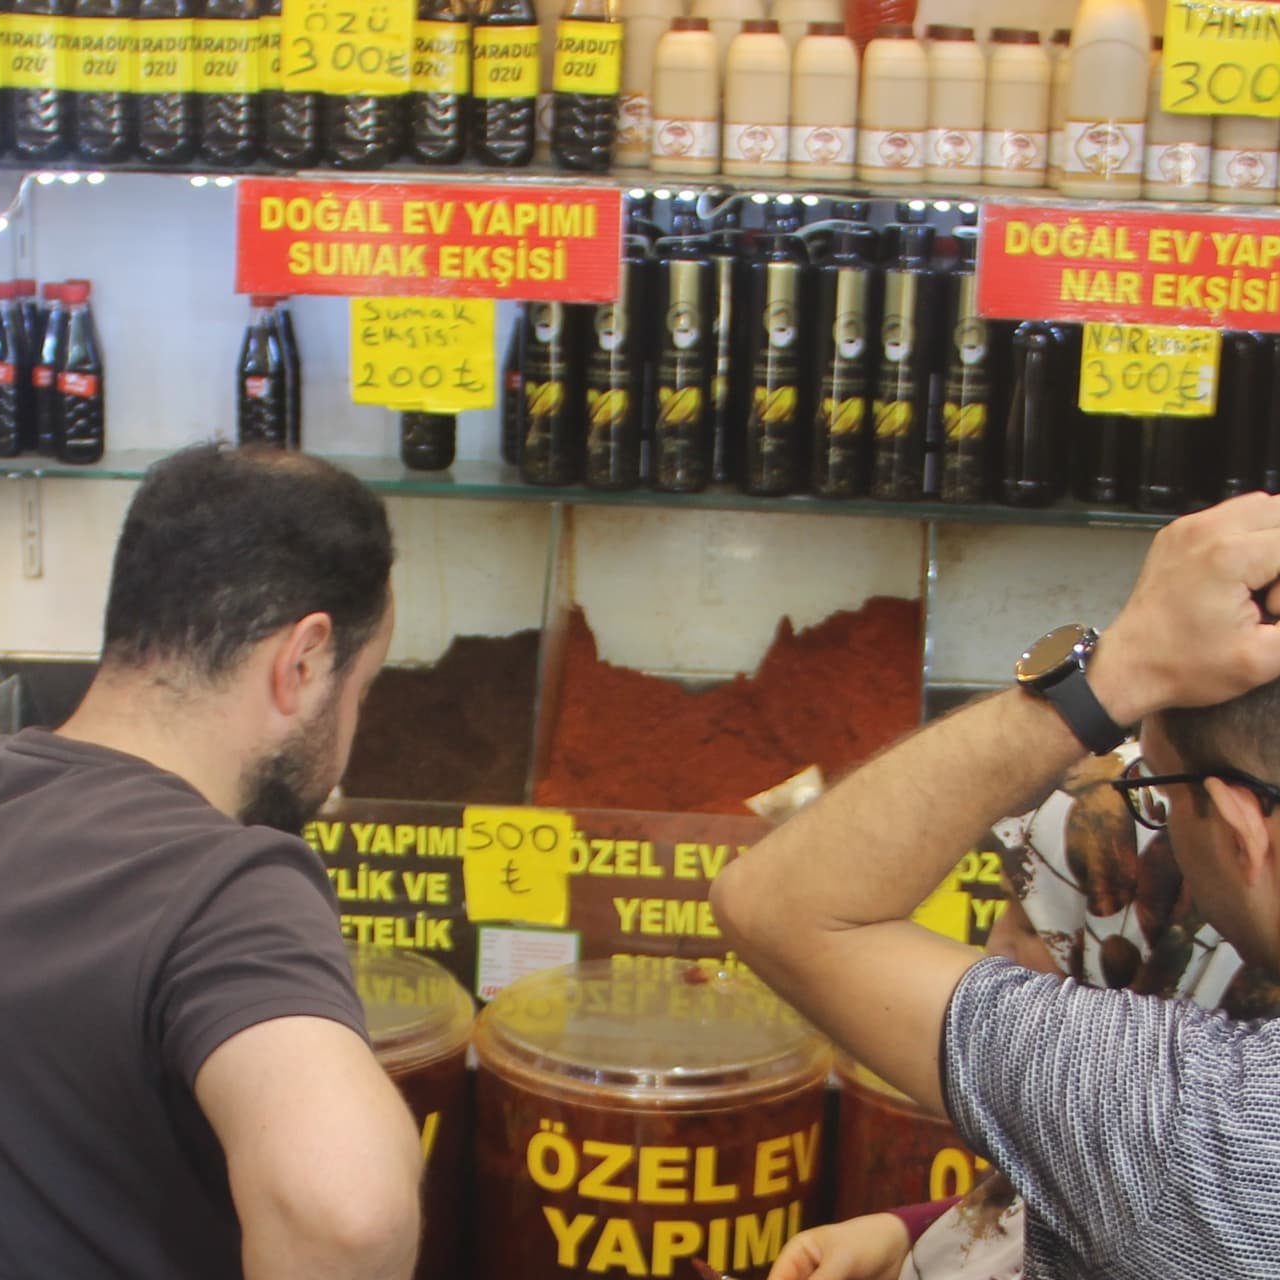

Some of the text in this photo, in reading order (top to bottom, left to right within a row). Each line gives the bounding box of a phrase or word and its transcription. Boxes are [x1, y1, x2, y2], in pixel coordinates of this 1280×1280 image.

[259, 189, 596, 240] DOĞAL EV YAPIMI
[288, 238, 568, 287] SUMAK EKŞİSİ
[1005, 216, 1137, 261] DOĞAL
[1147, 228, 1205, 264] EV
[1061, 267, 1280, 320] NAR EKŞİSİ
[349, 822, 466, 857] YAPIMI
[470, 820, 559, 852] 500
[569, 830, 728, 880] ÖZEL EV
[402, 871, 450, 902] VE
[613, 896, 722, 937] YEME
[526, 1120, 738, 1206] ÖZEL
[752, 1122, 820, 1200] EV
